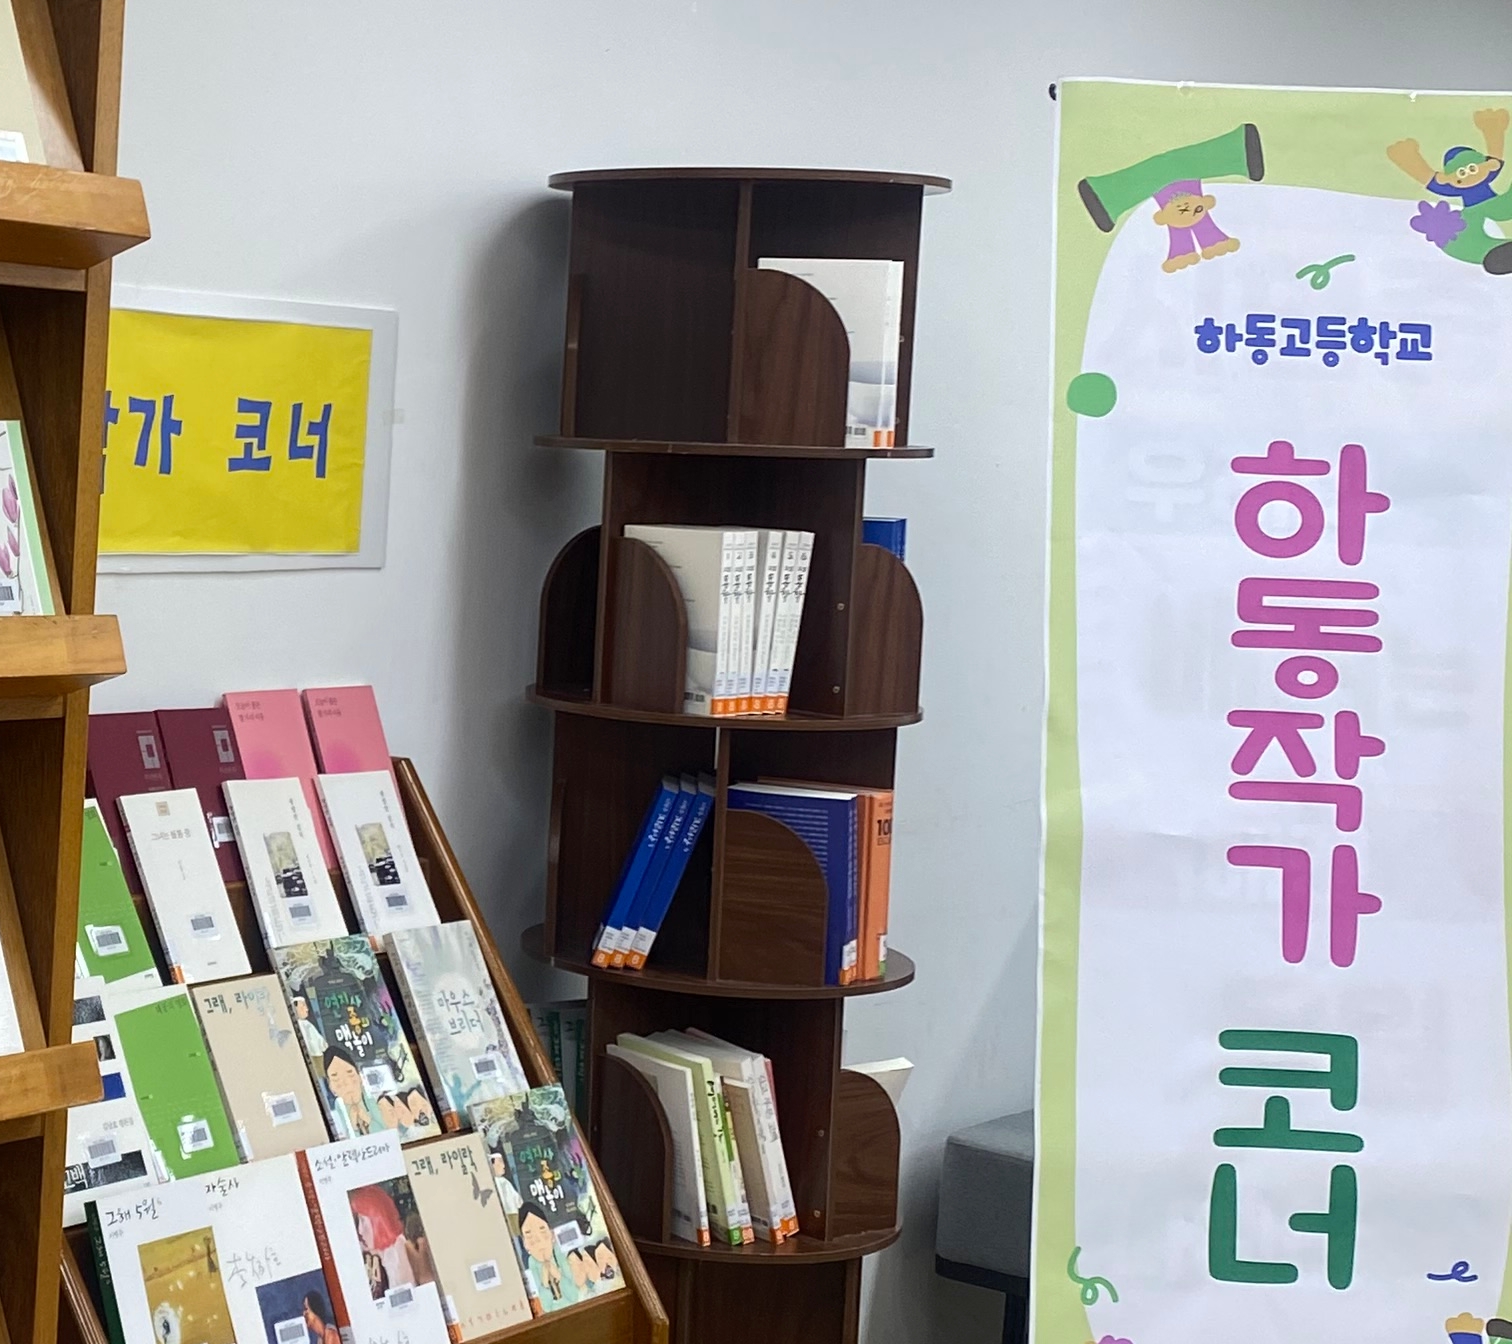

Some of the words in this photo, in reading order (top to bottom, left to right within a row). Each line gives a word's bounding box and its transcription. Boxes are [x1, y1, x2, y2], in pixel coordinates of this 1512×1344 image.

[1194, 312, 1433, 367] 하동고등학교
[228, 397, 332, 479] 코너
[1225, 441, 1390, 967] 하동작가
[412, 1157, 440, 1177] 그래,
[440, 1145, 478, 1175] 라일락
[1208, 1029, 1364, 1290] 코너
